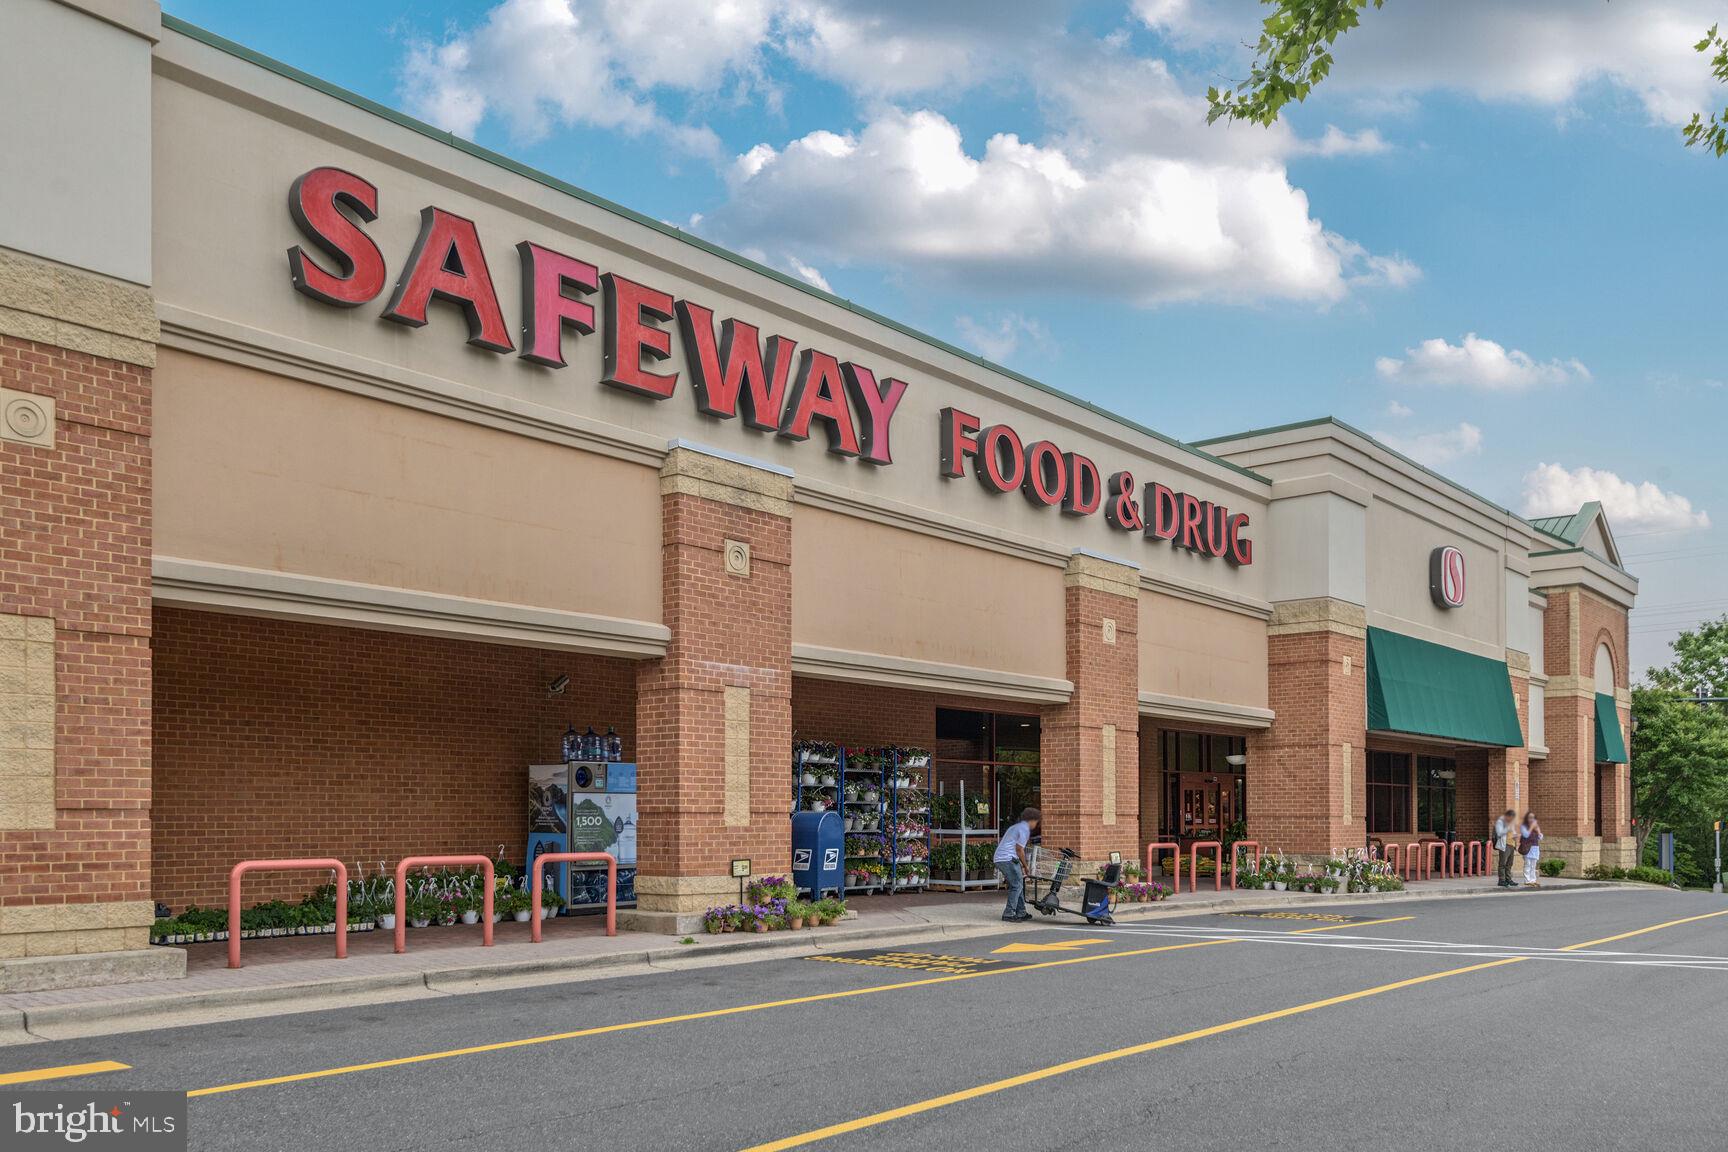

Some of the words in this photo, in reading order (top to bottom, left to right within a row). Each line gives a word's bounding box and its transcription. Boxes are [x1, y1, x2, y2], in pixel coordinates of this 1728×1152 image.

[287, 167, 908, 466] SAFEWAY
[940, 407, 1100, 516] FOOD
[1107, 471, 1143, 531] &
[1144, 481, 1252, 566] DRUG
[575, 816, 602, 827] 1,500
